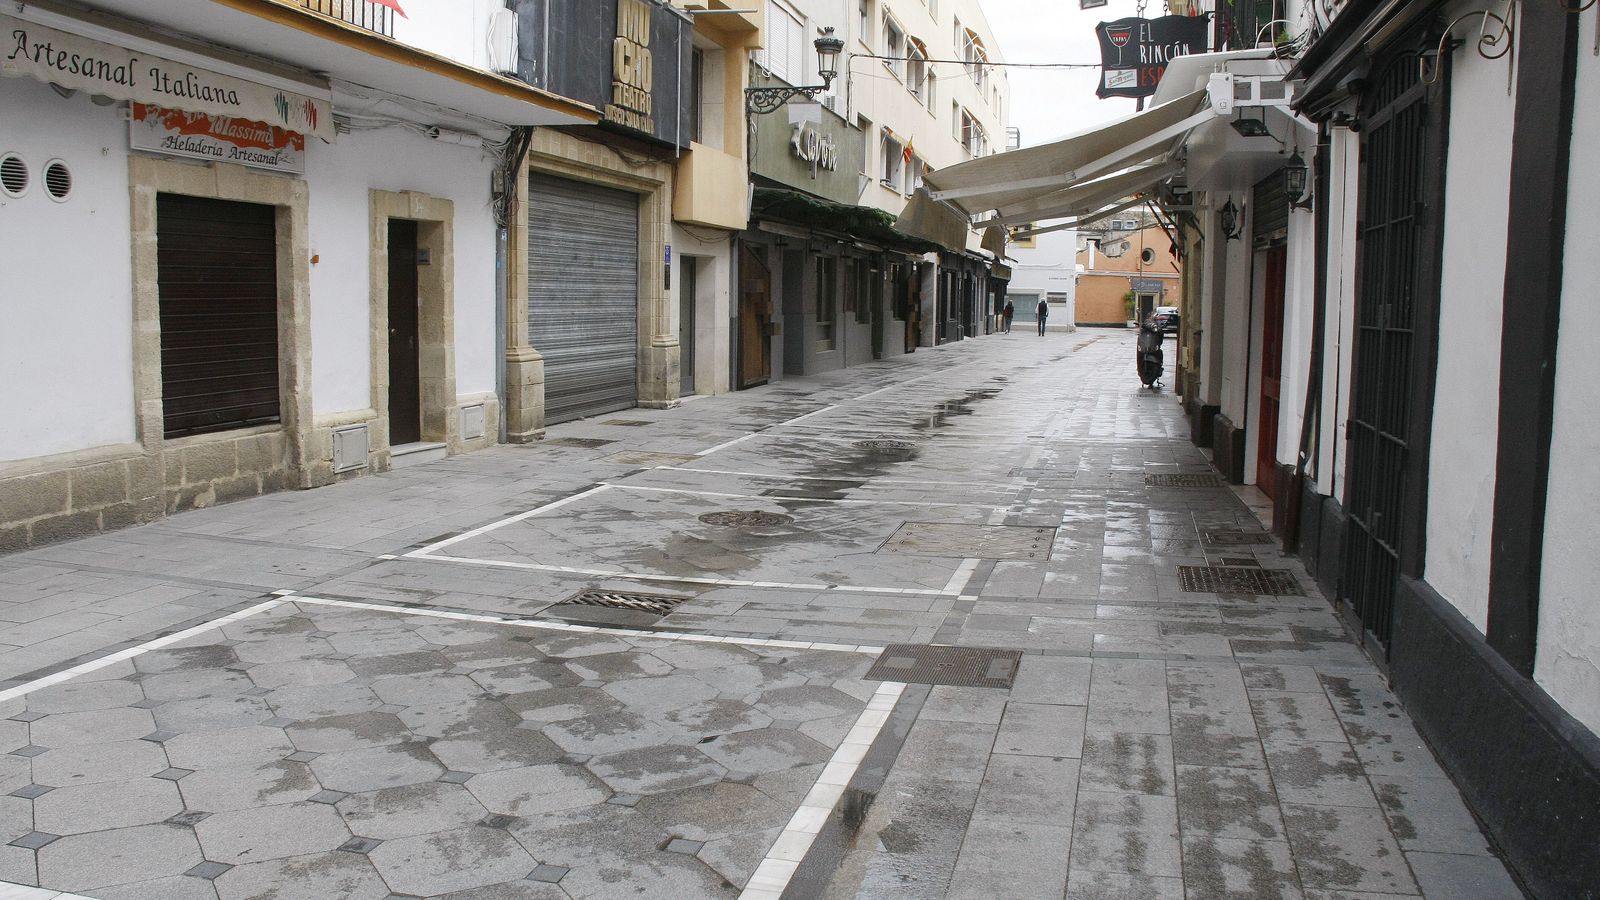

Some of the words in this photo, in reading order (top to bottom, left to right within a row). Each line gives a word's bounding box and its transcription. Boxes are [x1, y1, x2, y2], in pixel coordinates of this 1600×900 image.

[1139, 22, 1155, 43] EL
[7, 30, 137, 87] Artesanal
[150, 68, 241, 106] Italiana
[613, 37, 653, 93] CHO
[1139, 41, 1190, 64] RINCÓN
[1140, 66, 1165, 87] ESP
[612, 82, 652, 116] TEATRO
[165, 136, 223, 157] Heladería
[227, 146, 280, 167] Artesanal
